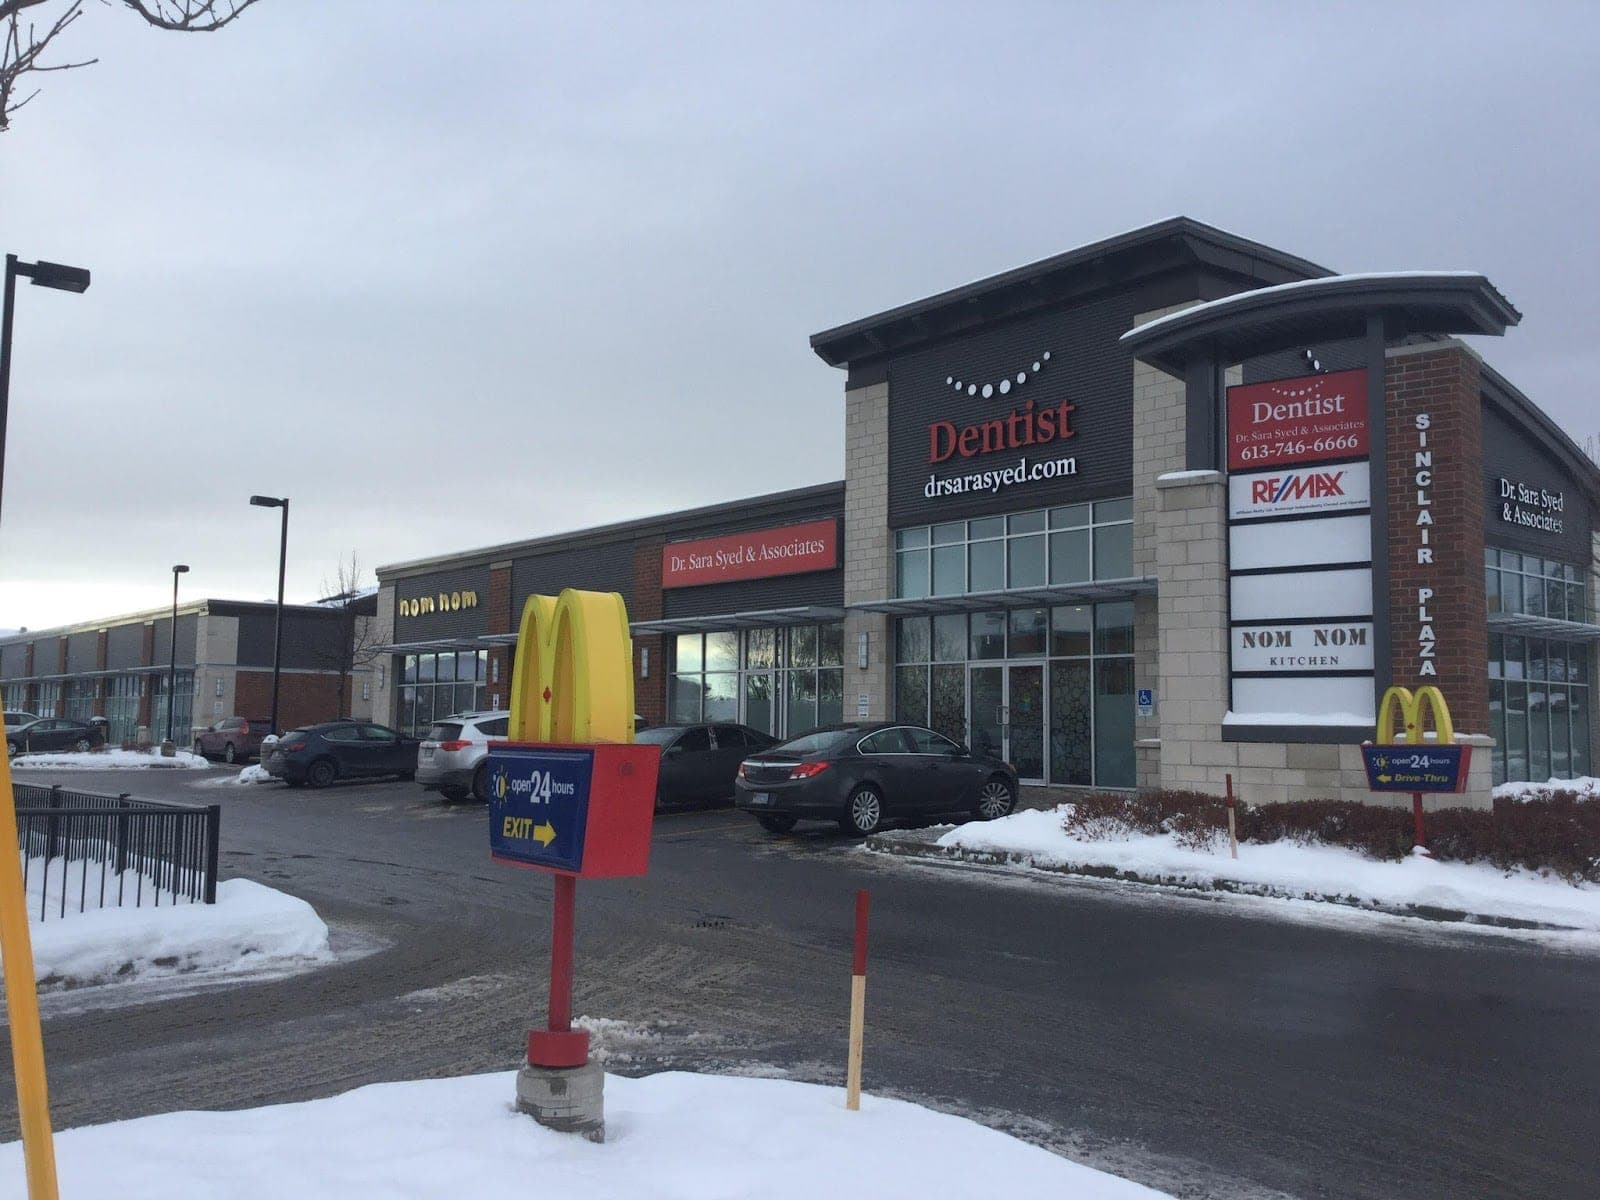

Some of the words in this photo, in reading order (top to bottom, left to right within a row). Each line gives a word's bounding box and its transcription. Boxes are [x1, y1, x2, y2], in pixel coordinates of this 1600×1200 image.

[1252, 393, 1345, 424] Dentist
[927, 399, 1075, 464] Dentist
[1235, 434, 1249, 444] Dr.
[1251, 432, 1273, 442] Sara
[1275, 426, 1298, 440] Syed
[1300, 426, 1309, 435] &
[1311, 420, 1365, 433] Associates
[1241, 433, 1358, 461] 613-746-6666
[924, 457, 1077, 498] drsarasyed.com
[1252, 471, 1345, 504] RE/MAX
[1415, 413, 1433, 564] SINCLAIR
[1500, 478, 1516, 500] Dr.
[1518, 482, 1539, 506] Sara
[1541, 488, 1564, 513] Syed
[1502, 502, 1513, 521] &
[1514, 506, 1563, 534] Associates
[671, 556, 686, 572] Dr.
[688, 553, 713, 570] Sara
[715, 546, 743, 569] Syed
[745, 546, 755, 562] &
[759, 539, 825, 561] Associates
[399, 597, 435, 617] nom
[439, 591, 477, 612] nom
[1242, 630, 1293, 649] NOM
[1313, 628, 1367, 647] NOM
[1418, 588, 1436, 676] PLAZA
[1269, 655, 1340, 666] KITCHEN
[1392, 758, 1411, 766] open
[1410, 755, 1430, 769] 24
[511, 779, 531, 797] open
[530, 770, 551, 804] 24
[552, 780, 574, 795] hours
[1394, 774, 1448, 783] Drive-Thru
[502, 816, 533, 840] EXIT
